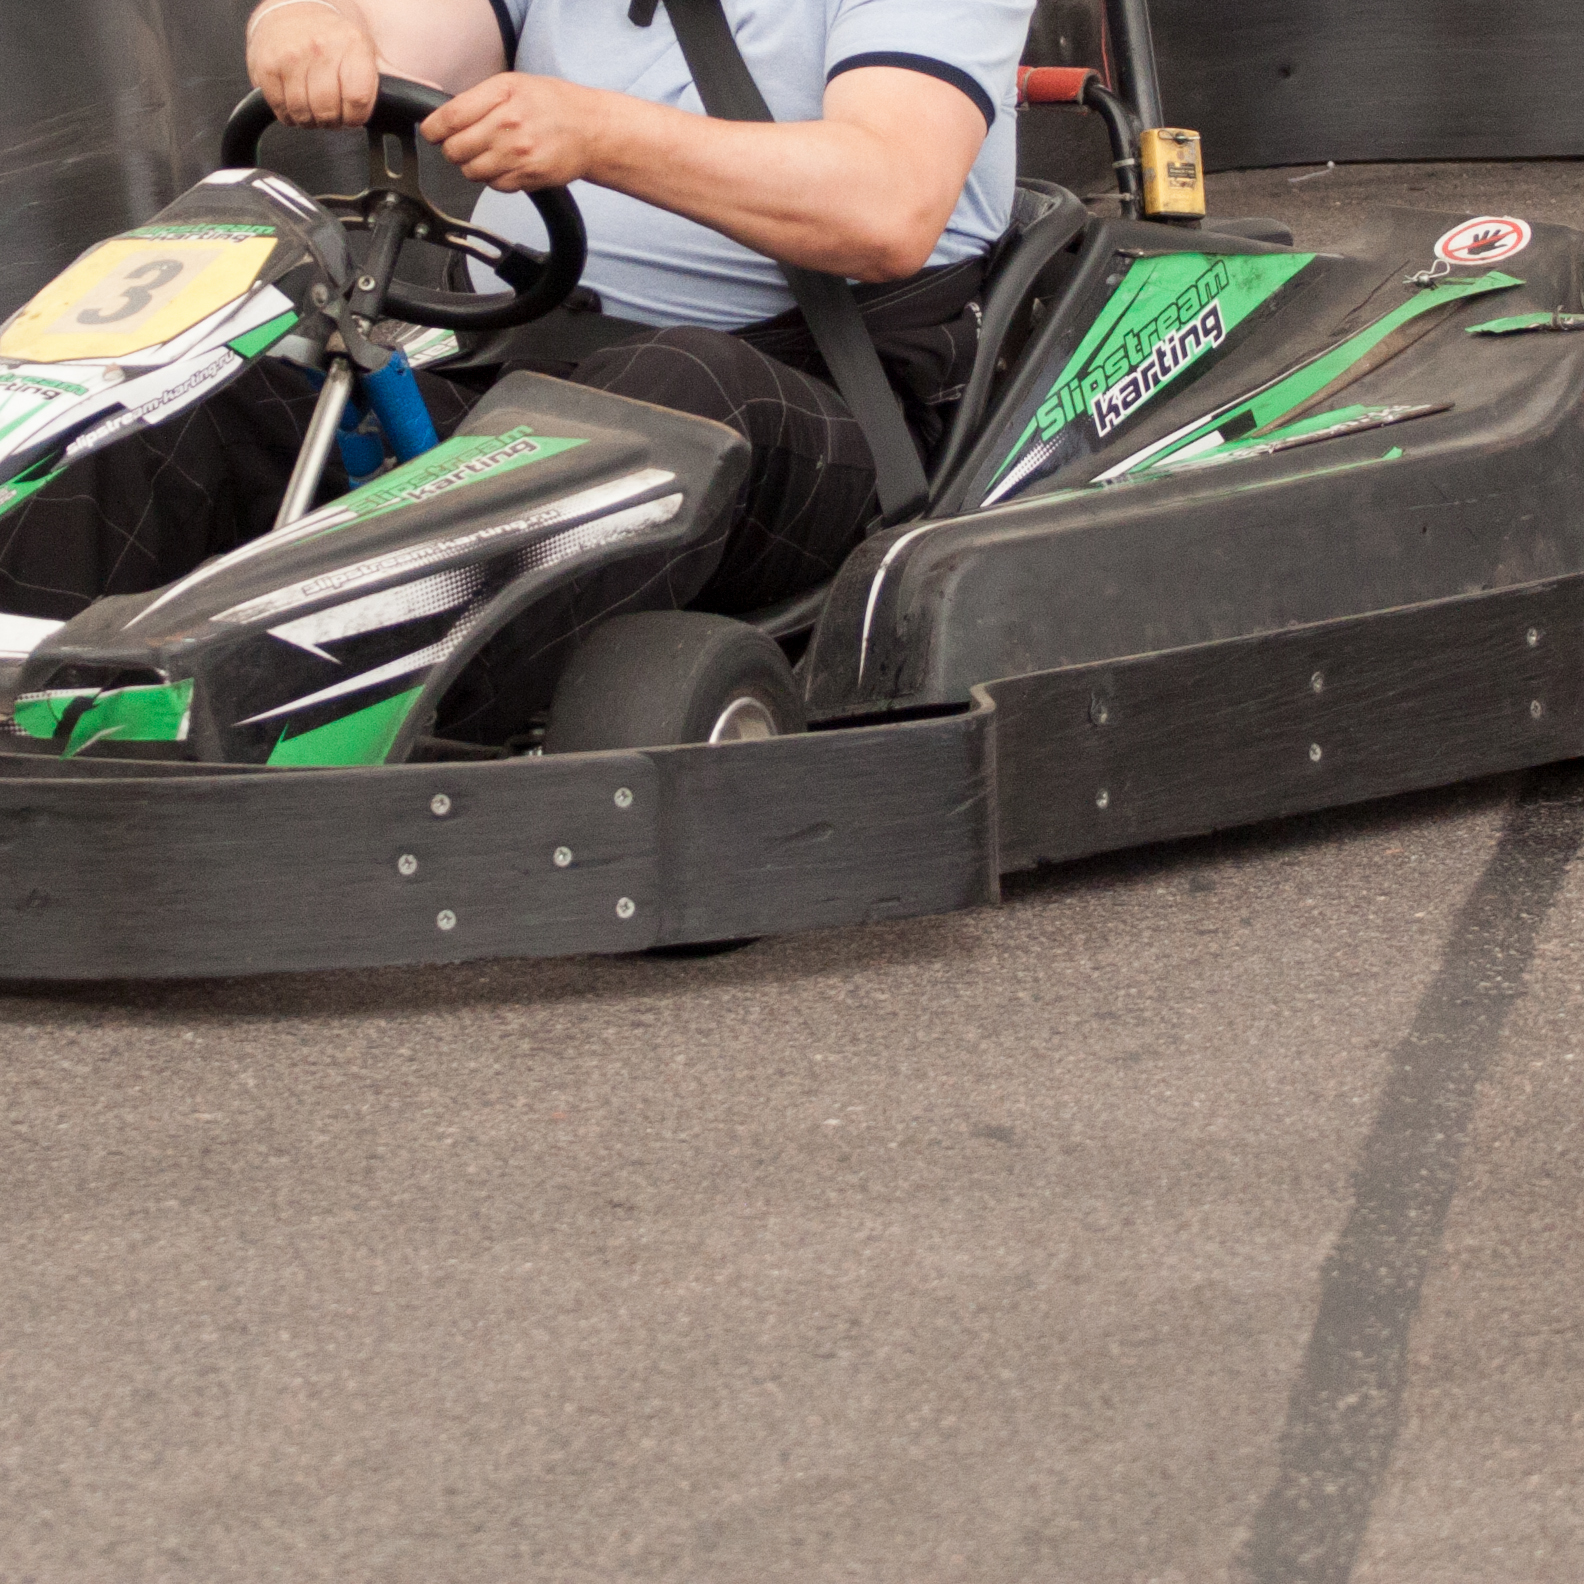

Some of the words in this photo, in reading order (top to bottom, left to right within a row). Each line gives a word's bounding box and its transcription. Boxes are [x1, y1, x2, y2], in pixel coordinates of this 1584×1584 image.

[76, 258, 184, 325] 3
[66, 350, 235, 457] slipstream-karting.ru
[1036, 259, 1230, 443] Slipstream
[1092, 299, 1226, 438] karting
[405, 436, 538, 503] karting
